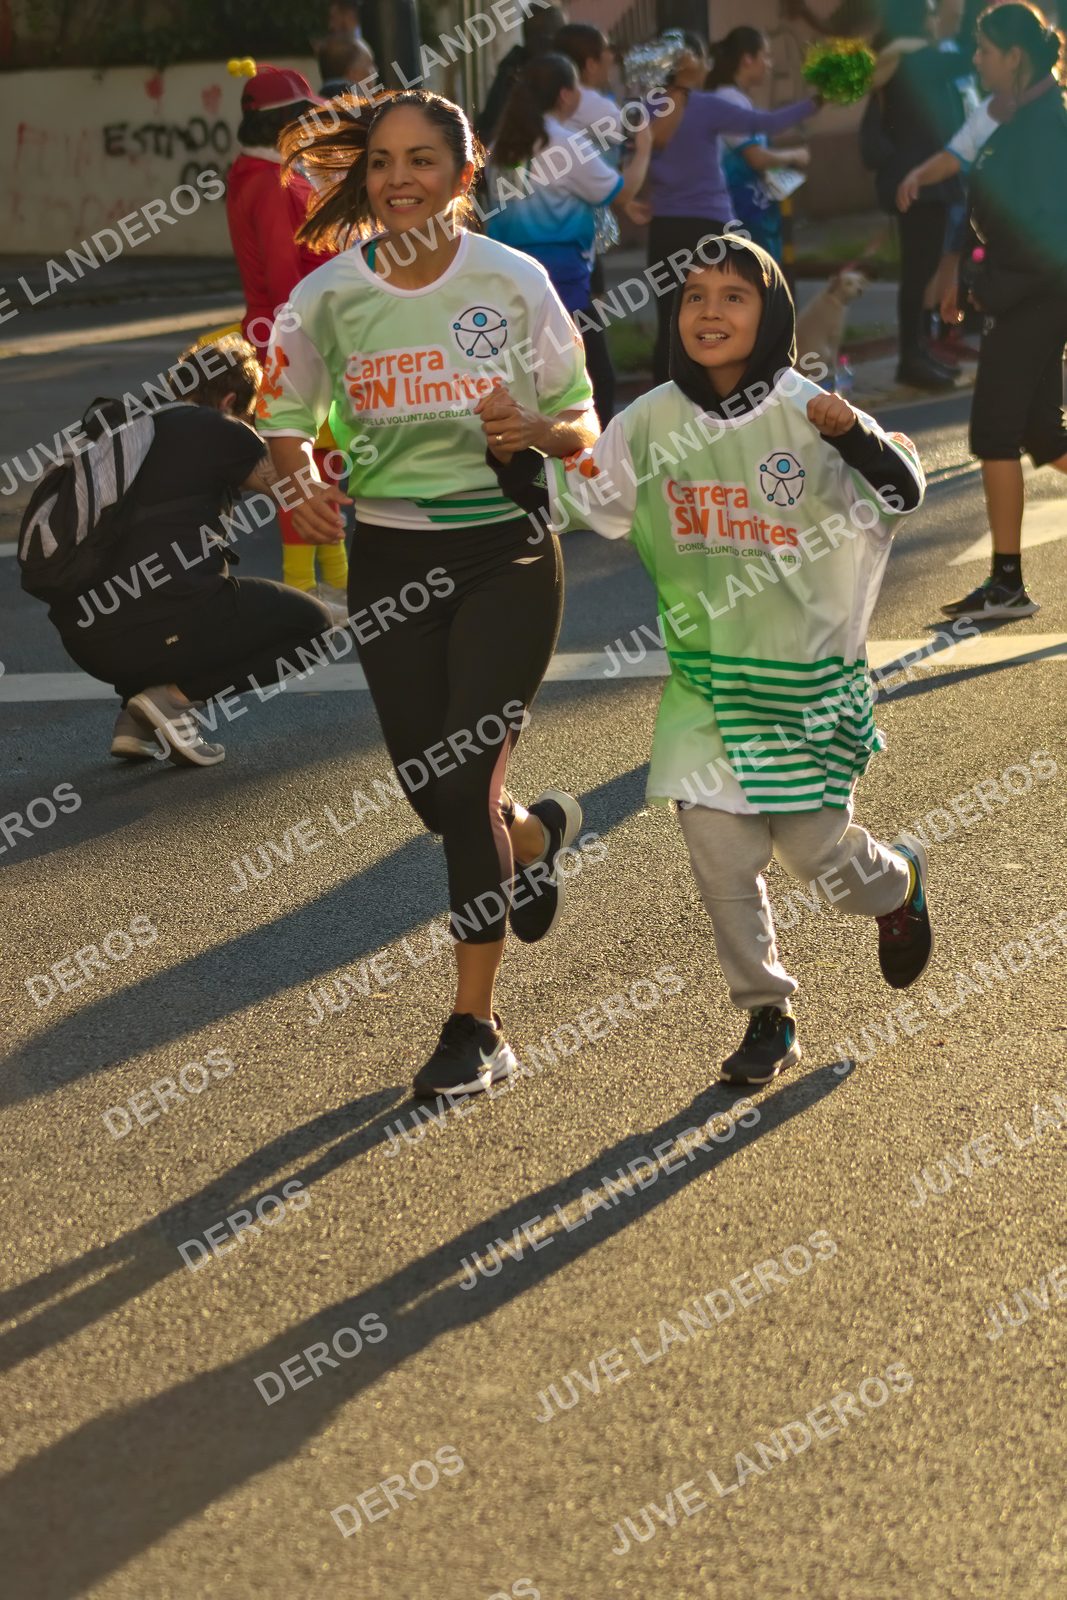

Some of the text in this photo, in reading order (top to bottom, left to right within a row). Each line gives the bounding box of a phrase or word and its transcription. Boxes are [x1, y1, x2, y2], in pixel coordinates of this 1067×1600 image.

[345, 350, 444, 382] Carrera
[349, 377, 396, 411] SIN
[387, 411, 437, 425] VOLUNTAD
[439, 408, 472, 418] CRUZA
